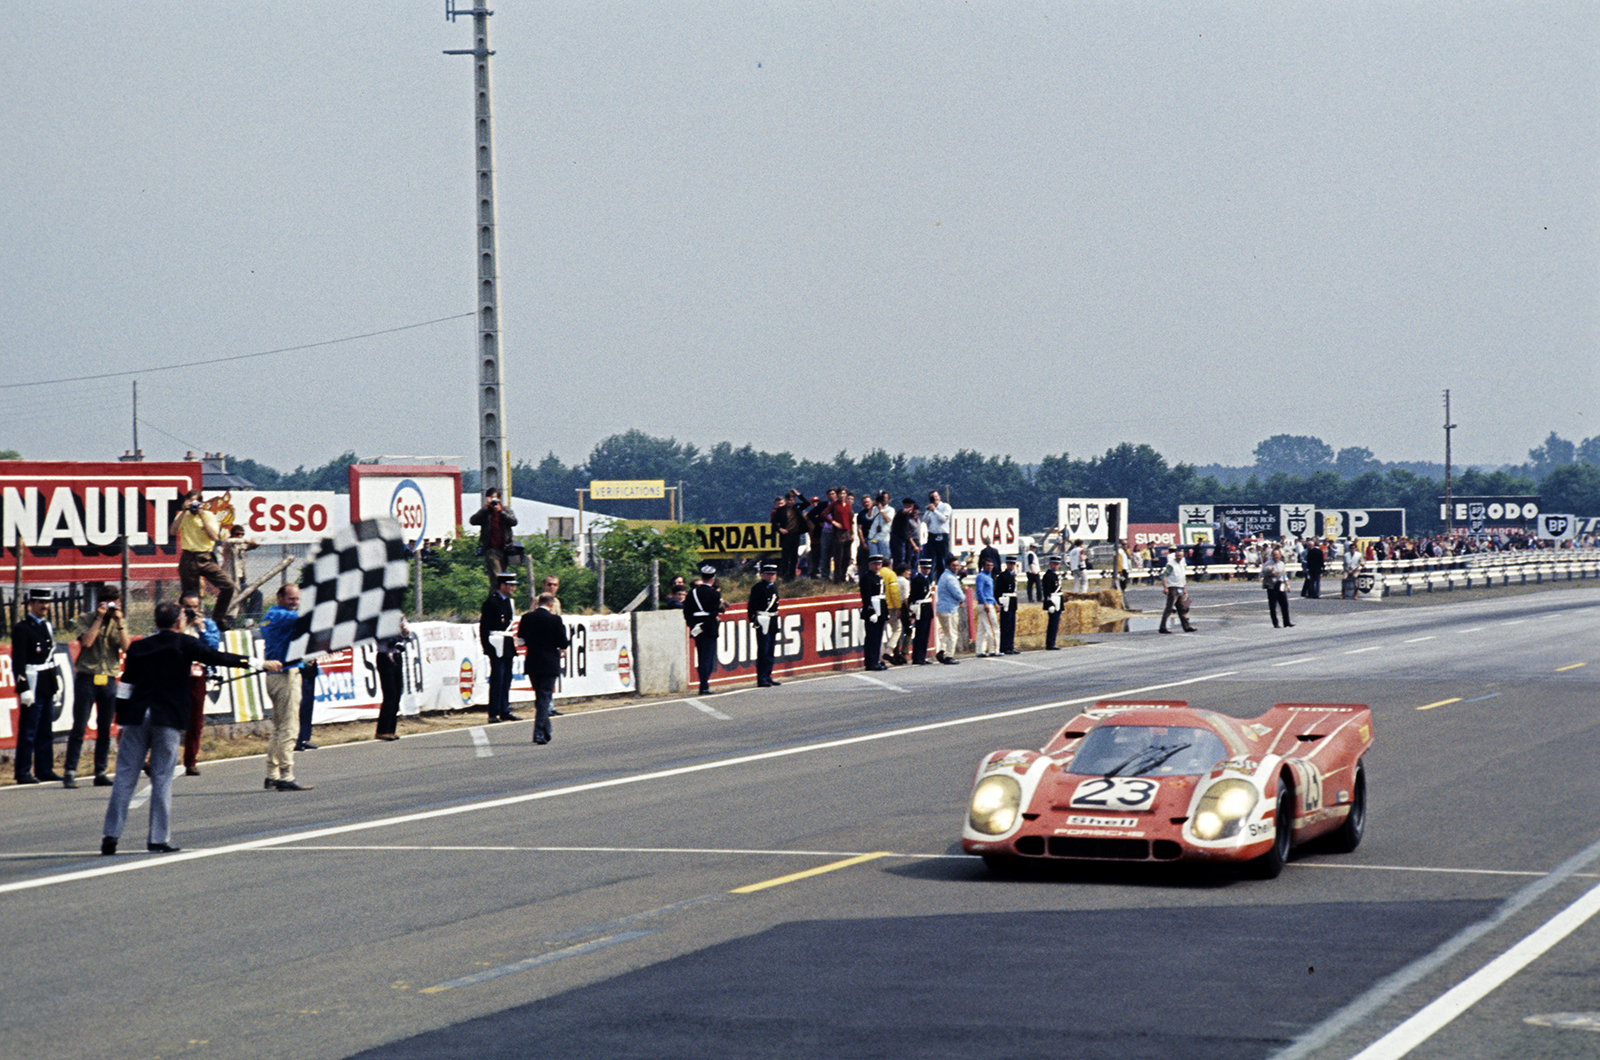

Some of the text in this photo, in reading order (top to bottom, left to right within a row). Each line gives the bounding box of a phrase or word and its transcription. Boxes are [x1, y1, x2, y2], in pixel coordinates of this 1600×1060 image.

[1069, 507, 1080, 525] BP
[1087, 507, 1099, 525] BP
[954, 517, 1014, 546] LUCAS
[1290, 521, 1306, 532] BP
[1548, 519, 1567, 532] BP
[696, 526, 778, 552] ARDAH
[1134, 532, 1176, 546] super
[1358, 577, 1374, 589] BP
[1072, 779, 1155, 806] 23
[1070, 816, 1134, 827] Shell
[1054, 828, 1145, 838] PORSCHE
